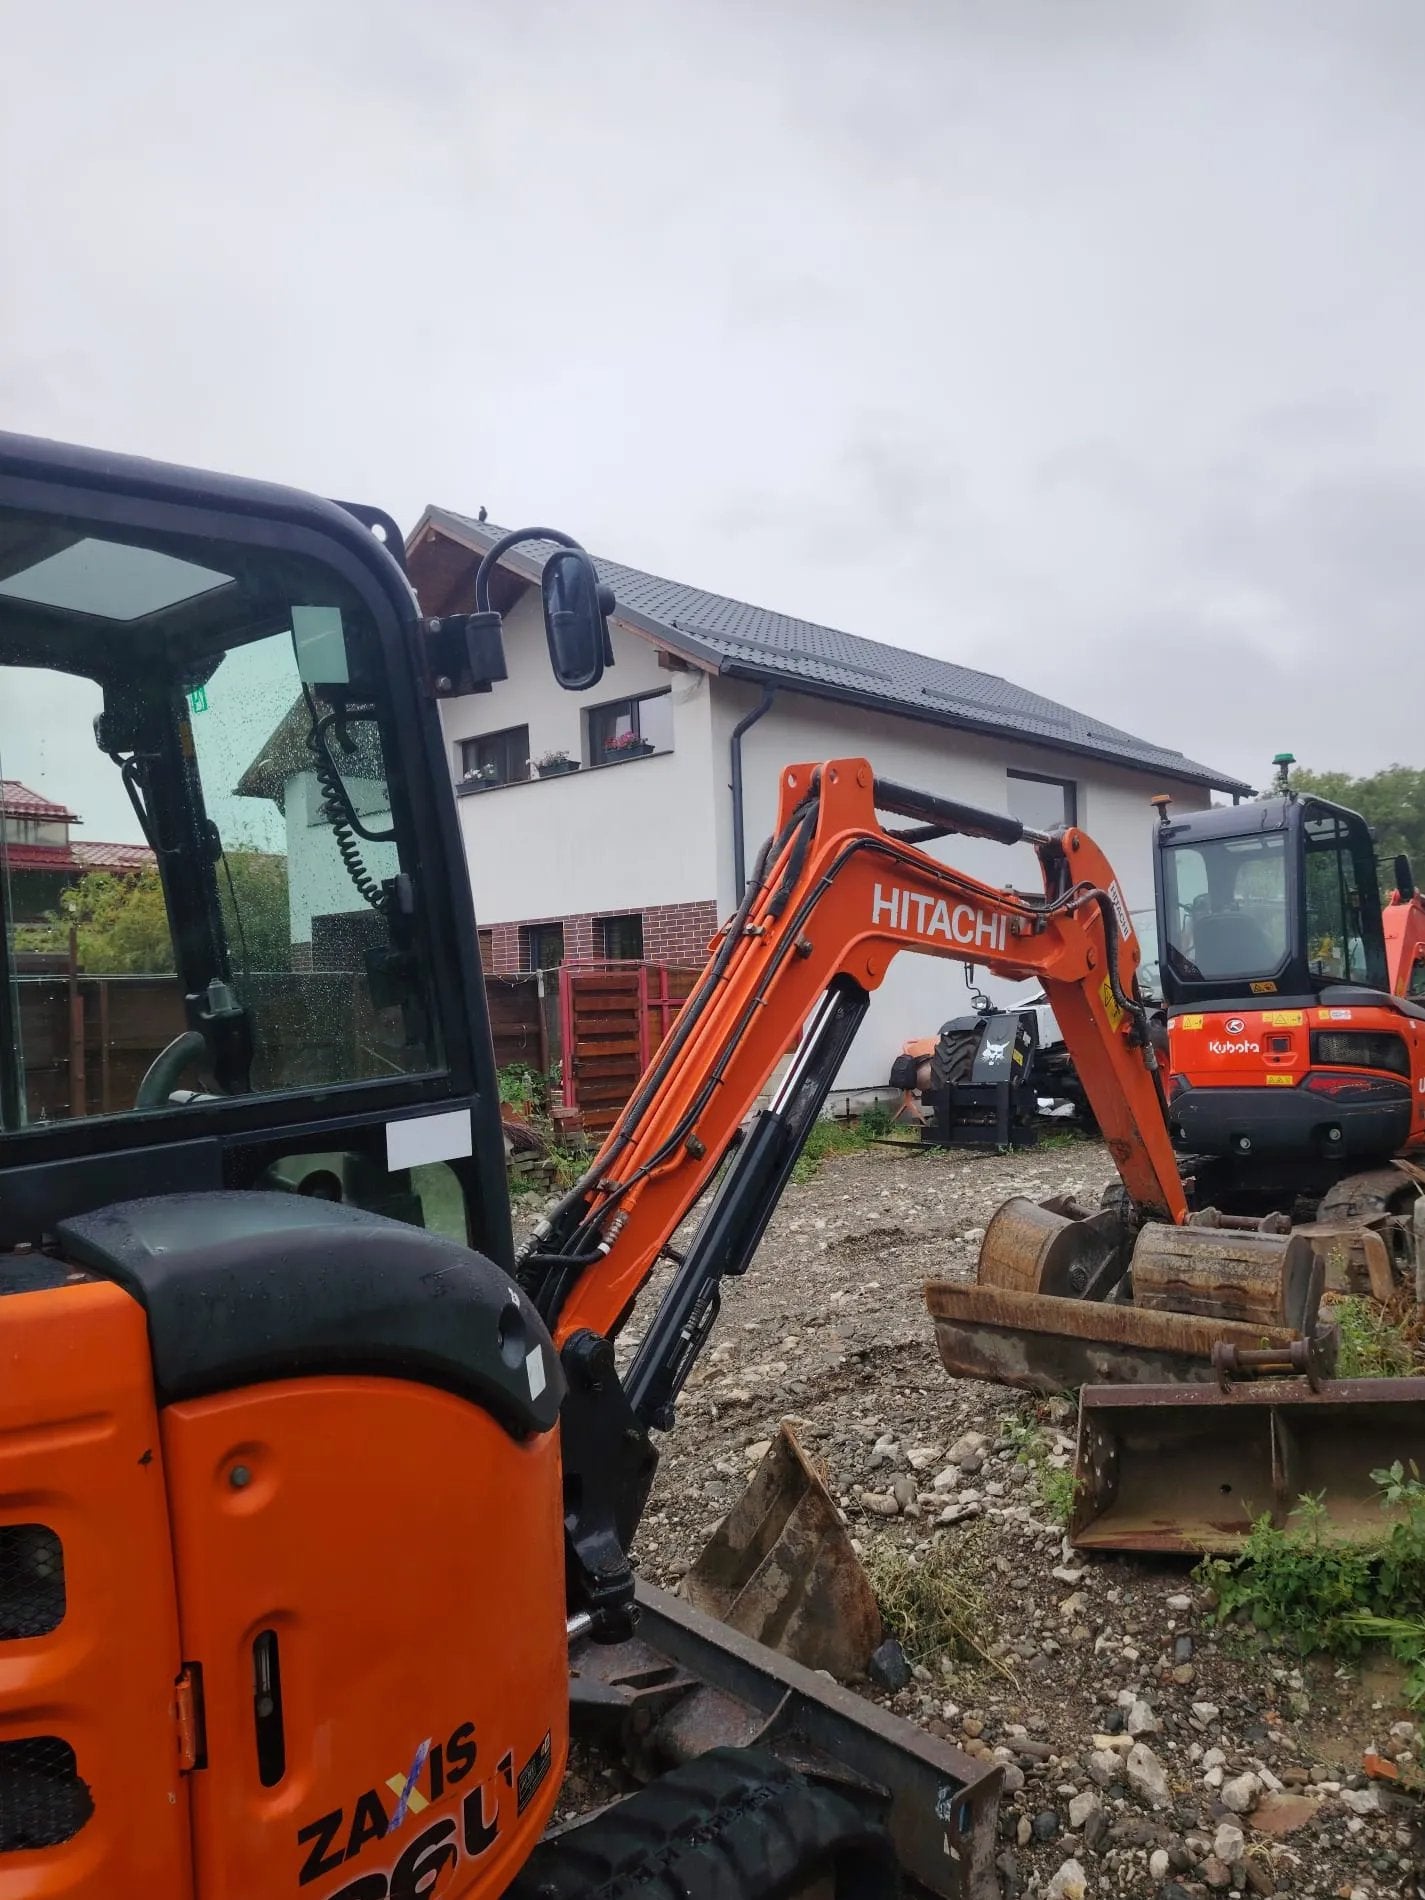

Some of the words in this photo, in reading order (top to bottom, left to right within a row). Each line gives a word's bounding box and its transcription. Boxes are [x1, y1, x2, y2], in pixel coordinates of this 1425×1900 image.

[871, 883, 1007, 951] HITACHI
[1209, 1040, 1260, 1055] Kubota
[298, 1721, 476, 1887] ZAXIS
